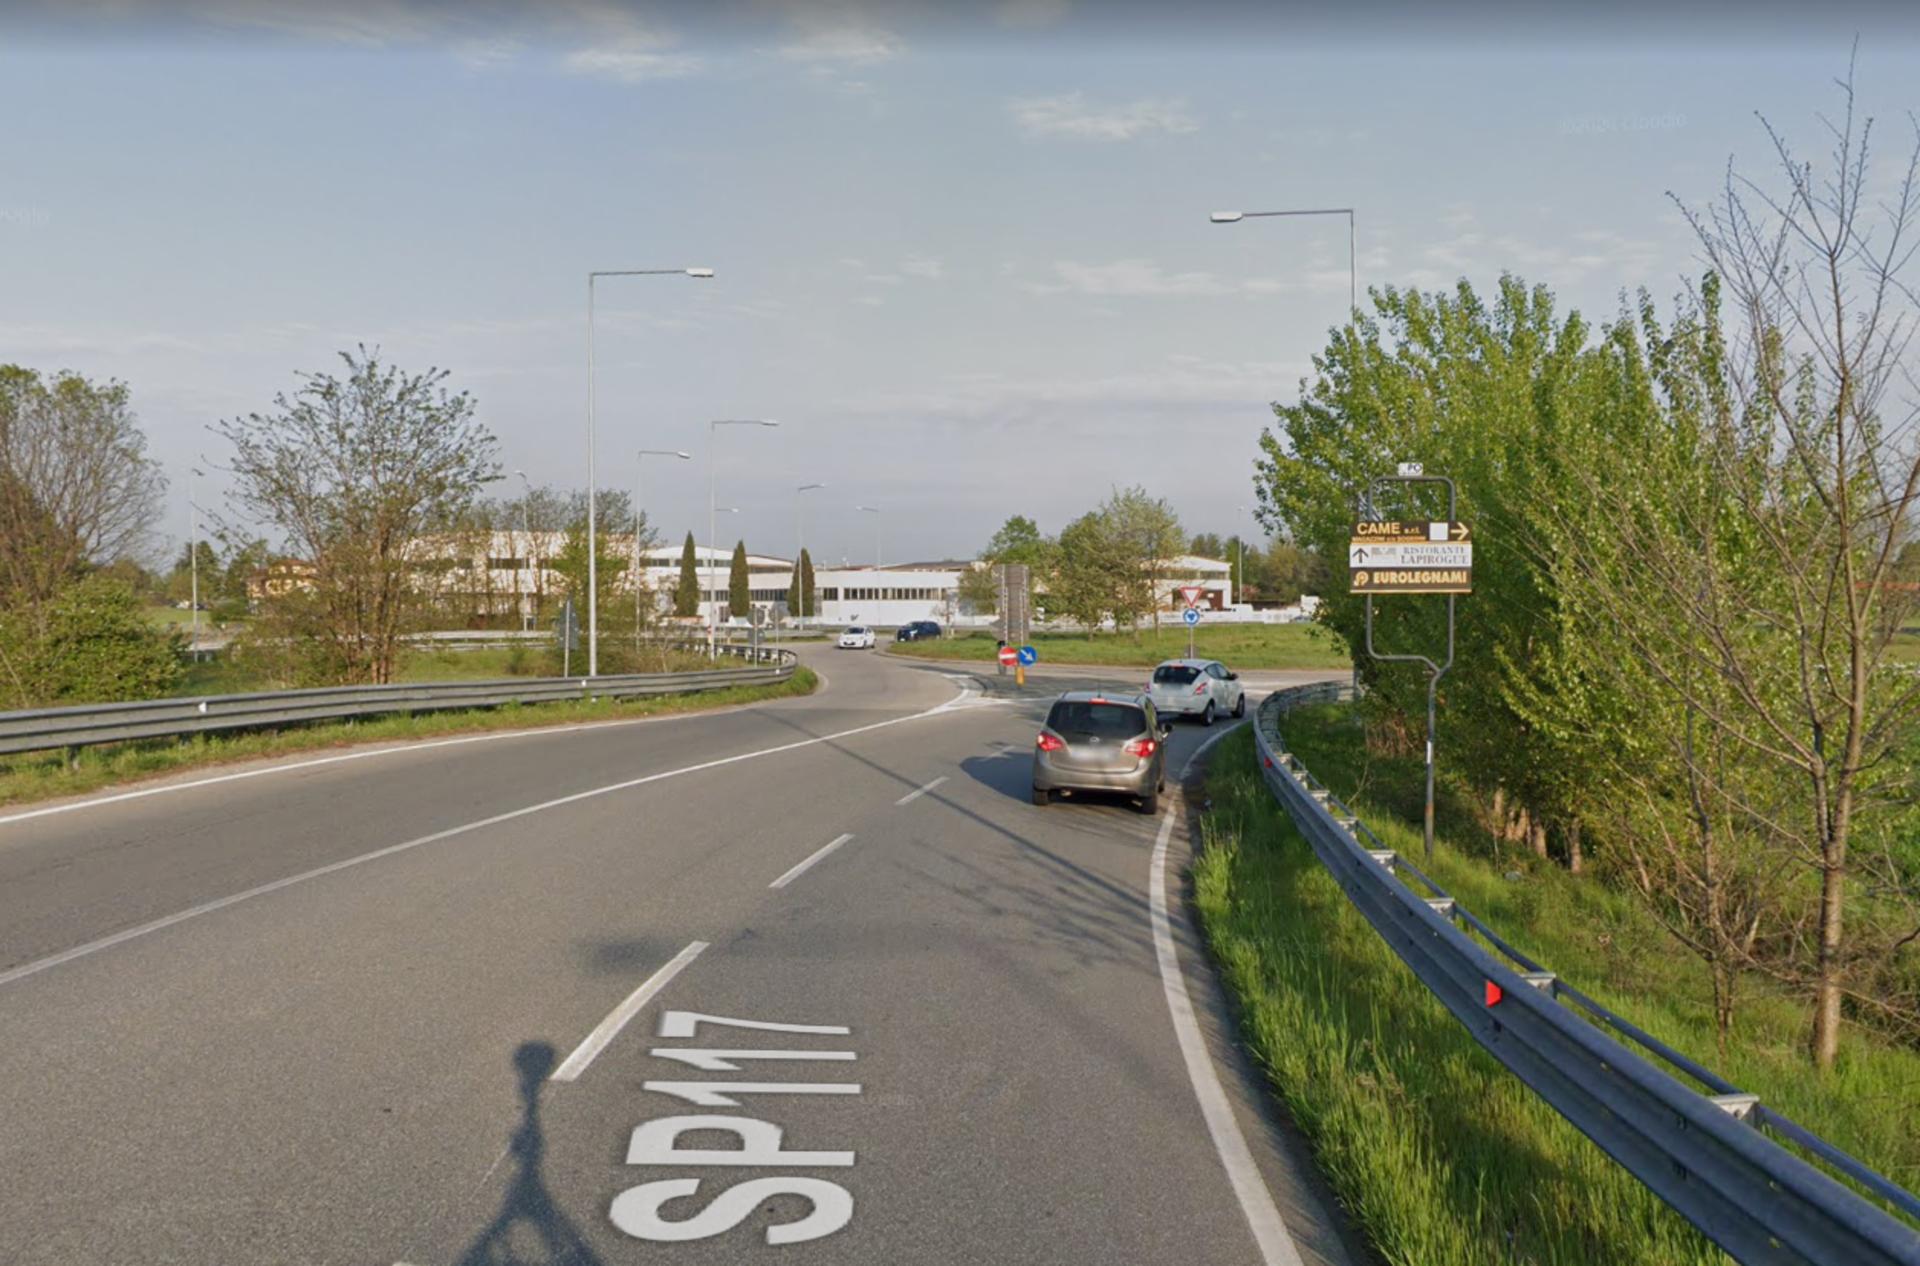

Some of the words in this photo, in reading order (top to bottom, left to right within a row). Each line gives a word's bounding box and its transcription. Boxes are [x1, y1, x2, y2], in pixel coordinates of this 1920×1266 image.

[1357, 522, 1400, 535] CAME
[1373, 570, 1467, 584] EUROLEGNAMI
[609, 1010, 861, 1245] SP117
